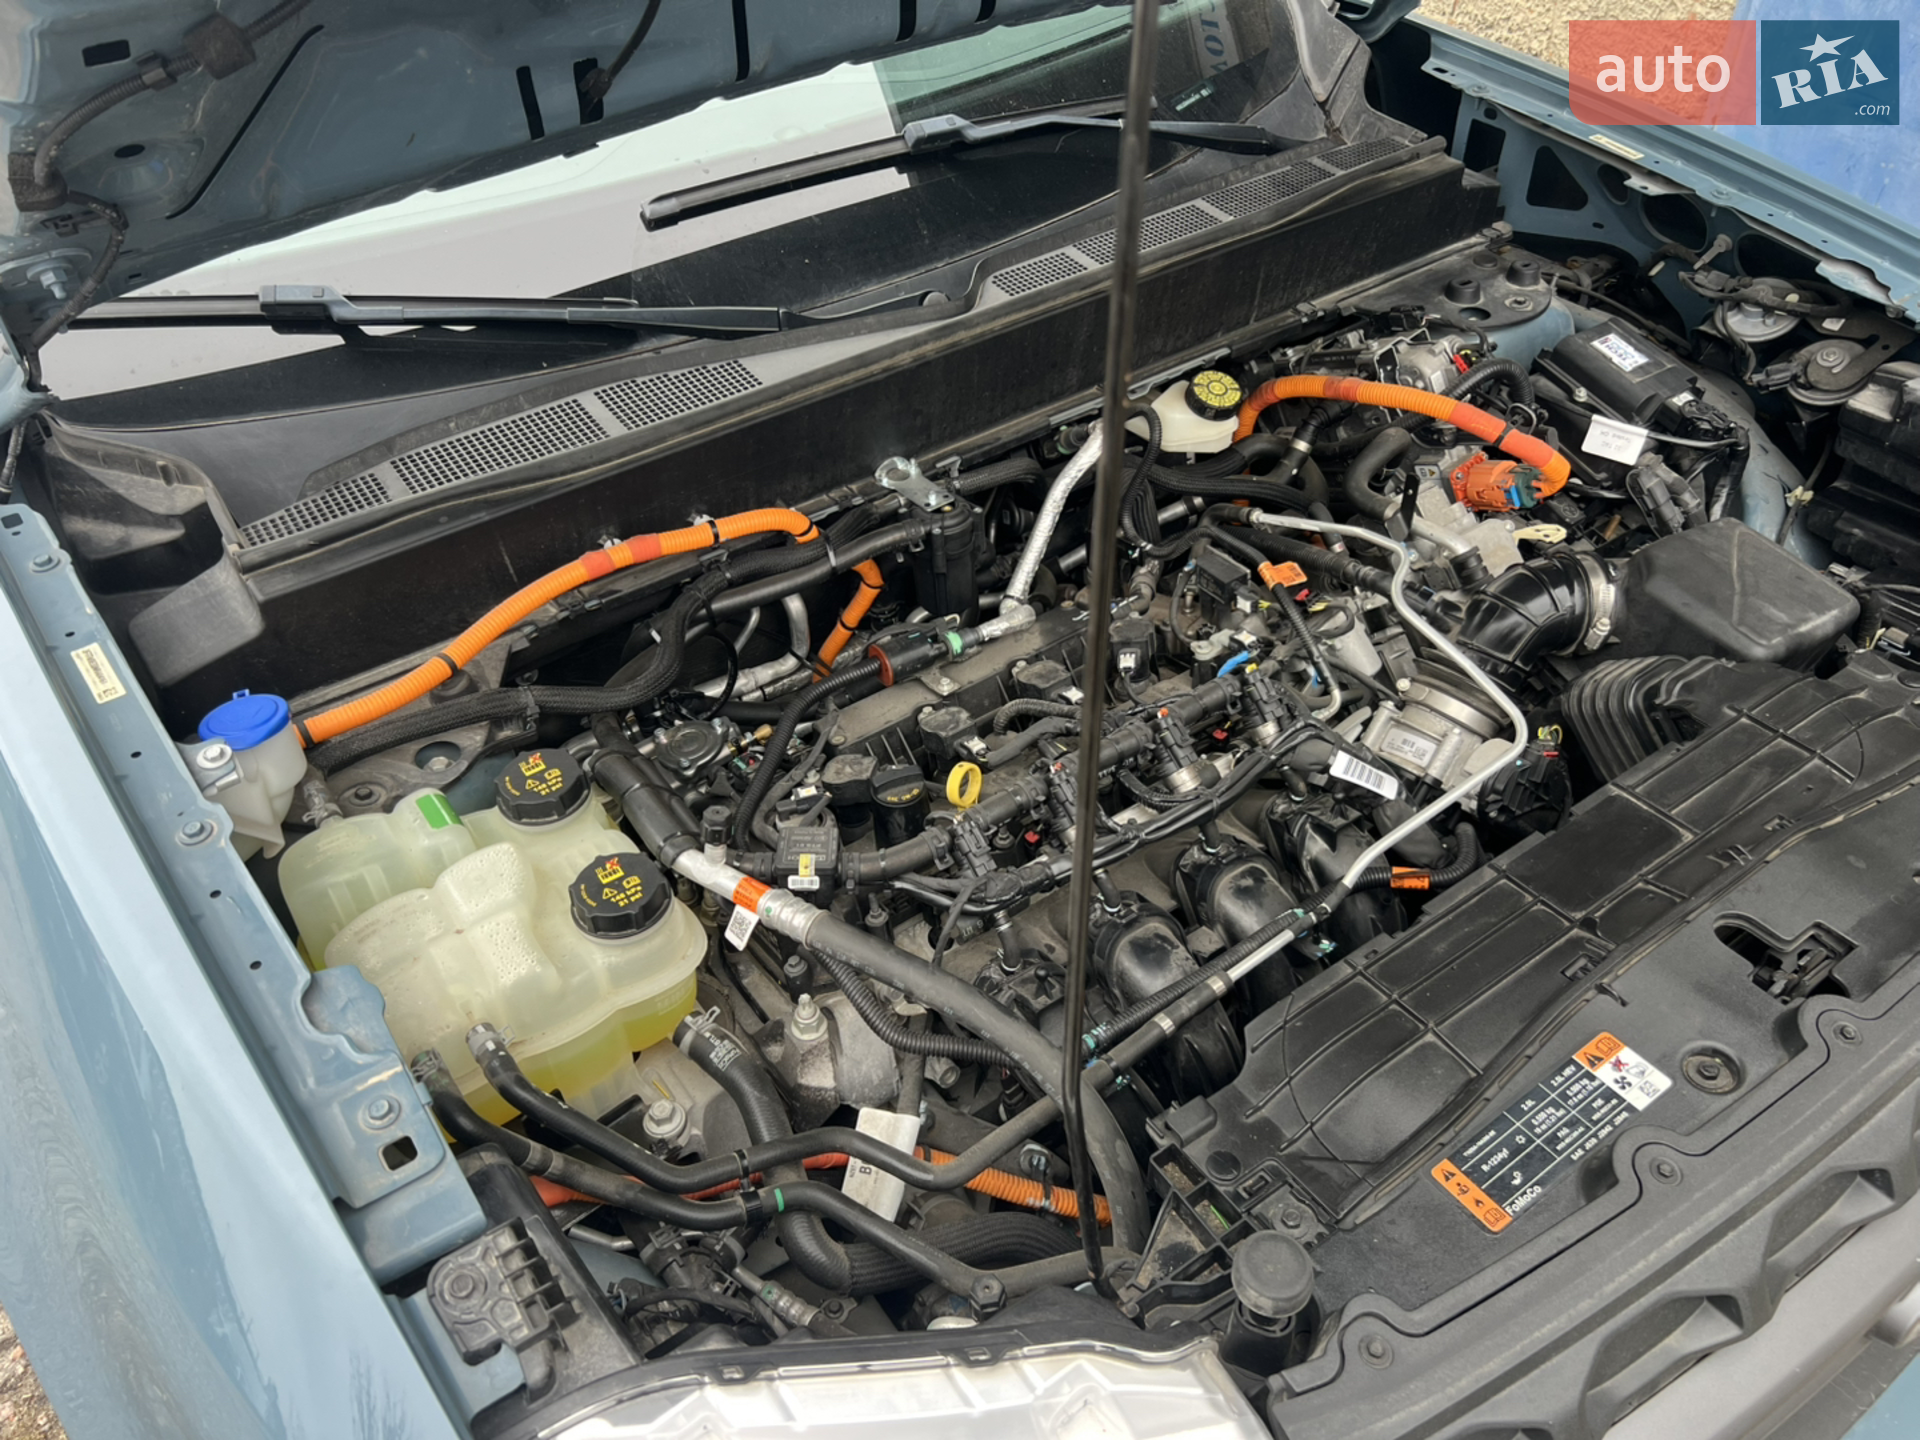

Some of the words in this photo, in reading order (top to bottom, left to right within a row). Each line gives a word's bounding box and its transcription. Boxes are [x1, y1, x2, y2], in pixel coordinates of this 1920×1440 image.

[1480, 1147, 1510, 1173] R-1234yf
[1569, 1147, 1584, 1161] SAE
[1505, 1184, 1543, 1216] FoMoCo
